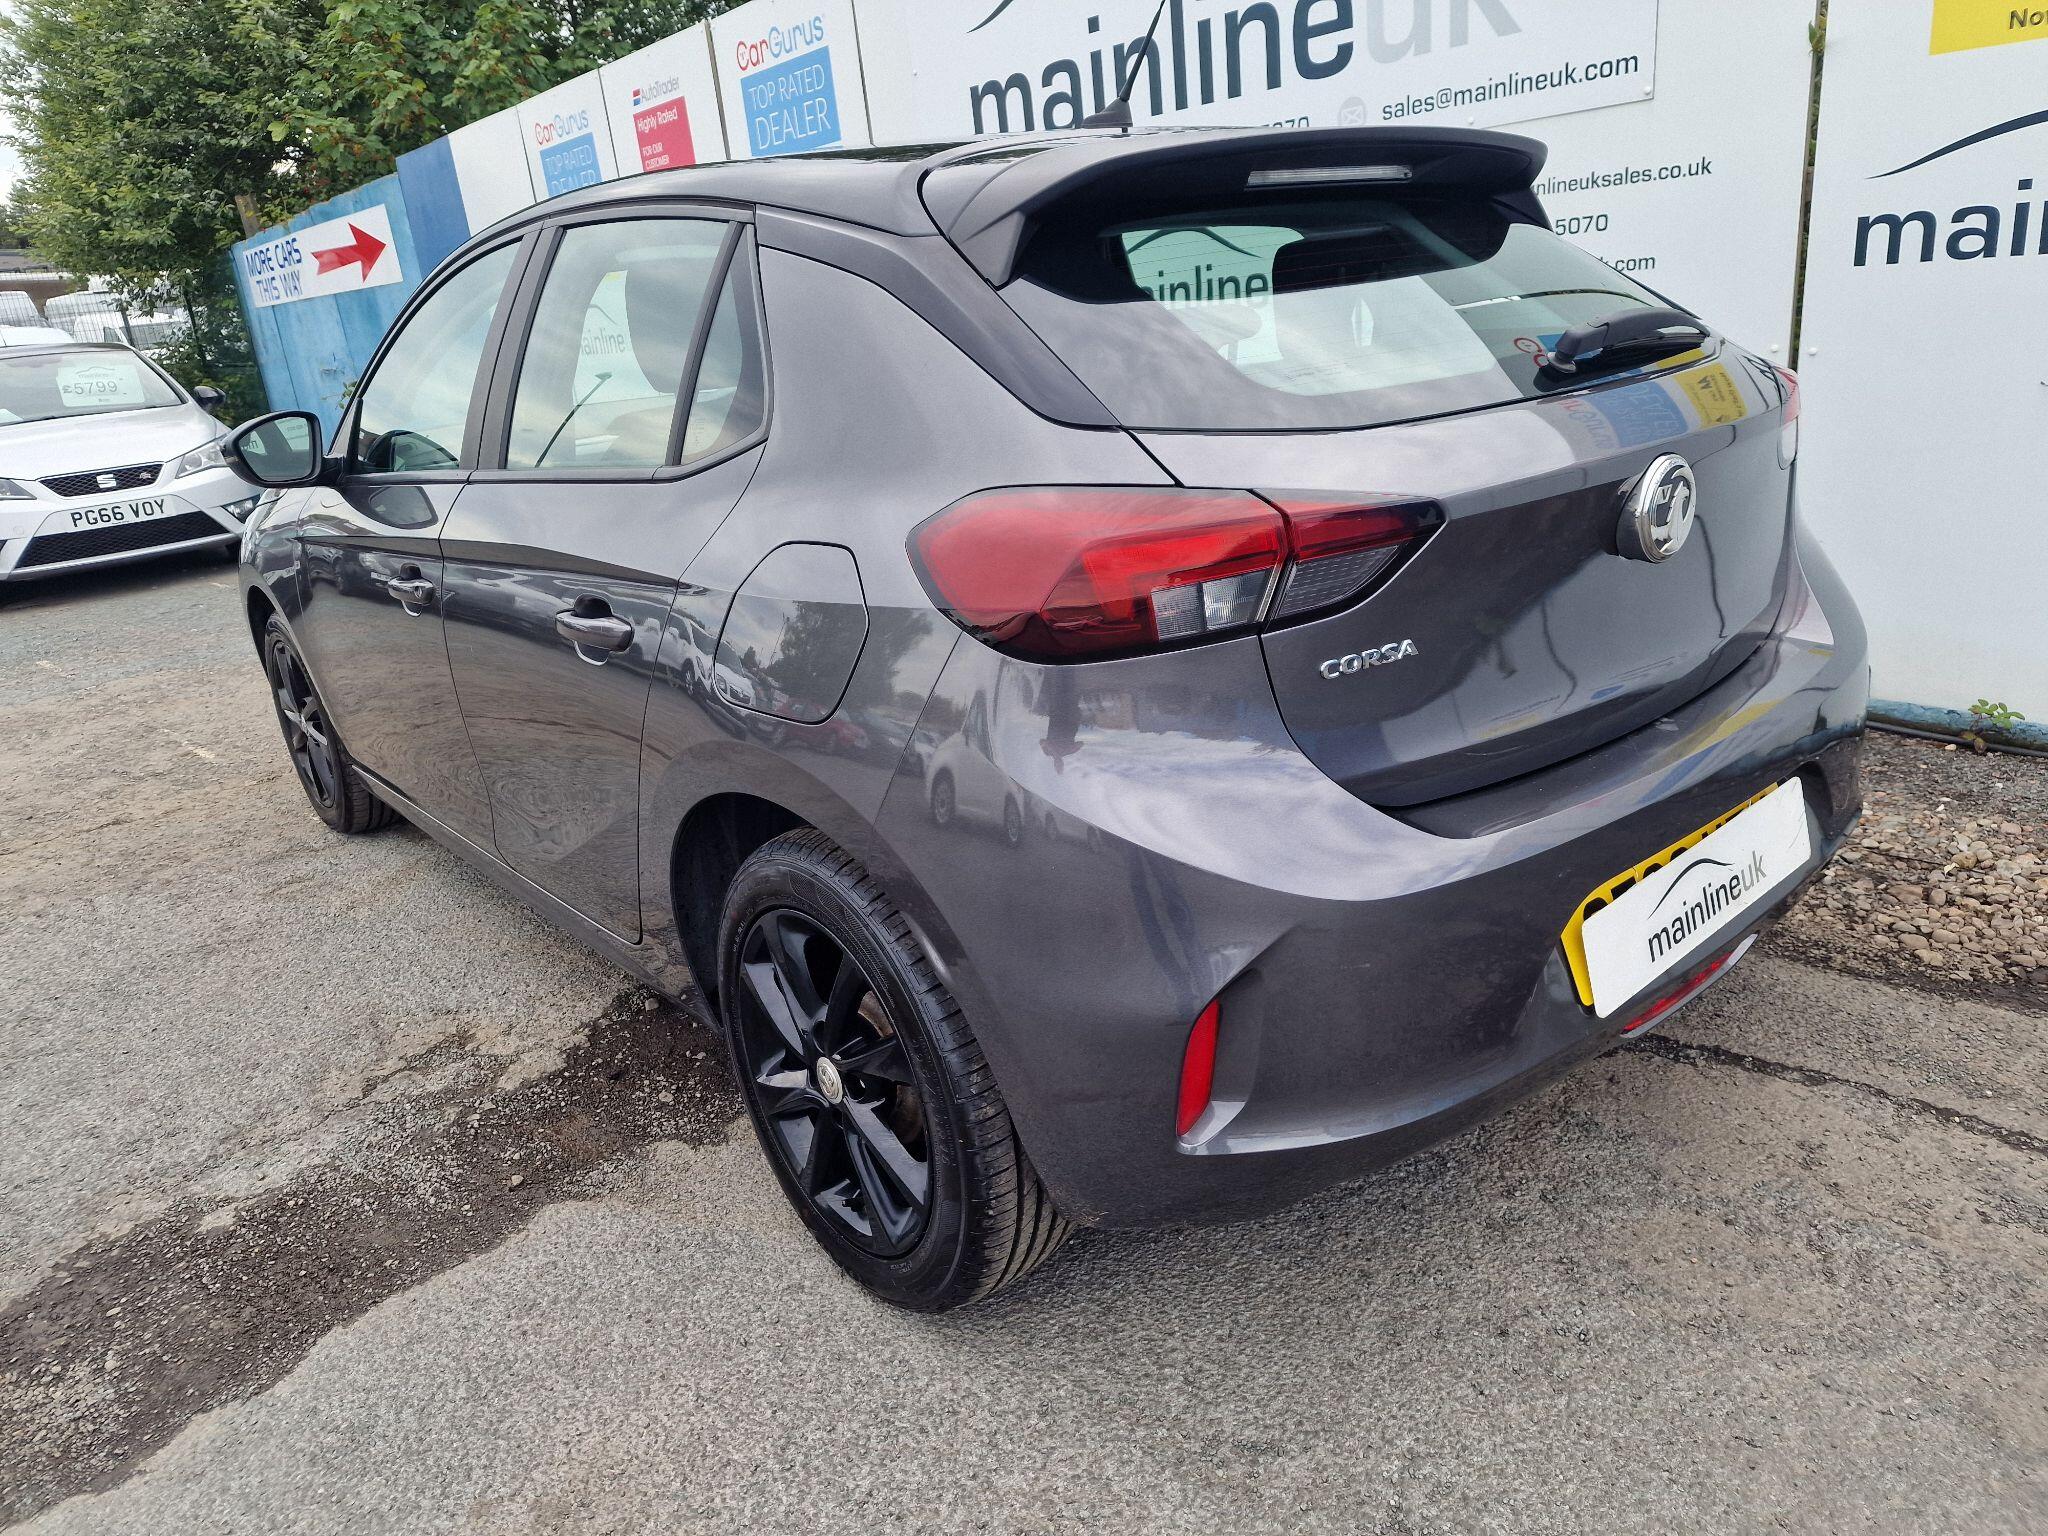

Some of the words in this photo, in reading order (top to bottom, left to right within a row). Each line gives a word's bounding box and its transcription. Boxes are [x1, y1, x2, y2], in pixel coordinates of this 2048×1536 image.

[2009, 7, 2048, 30] No
[736, 15, 825, 71] CarGurus
[749, 81, 776, 110] TOP
[779, 64, 826, 102] RATED
[1382, 53, 1639, 121] sales@mainlineuk.com
[535, 109, 590, 145] CarGurus
[637, 115, 658, 133] Highly
[657, 107, 678, 125] Rated
[755, 97, 832, 150] DEALER
[1555, 213, 1609, 236] 5070
[245, 247, 275, 278] MORE
[274, 237, 302, 269] CARS
[256, 276, 280, 303] THIS
[279, 270, 303, 298] WAY
[62, 380, 118, 395] £5799
[70, 505, 125, 528] PG66
[128, 499, 165, 518] VOY
[1319, 638, 1420, 680] CORSA
[1647, 850, 1768, 963] mainlineuk
